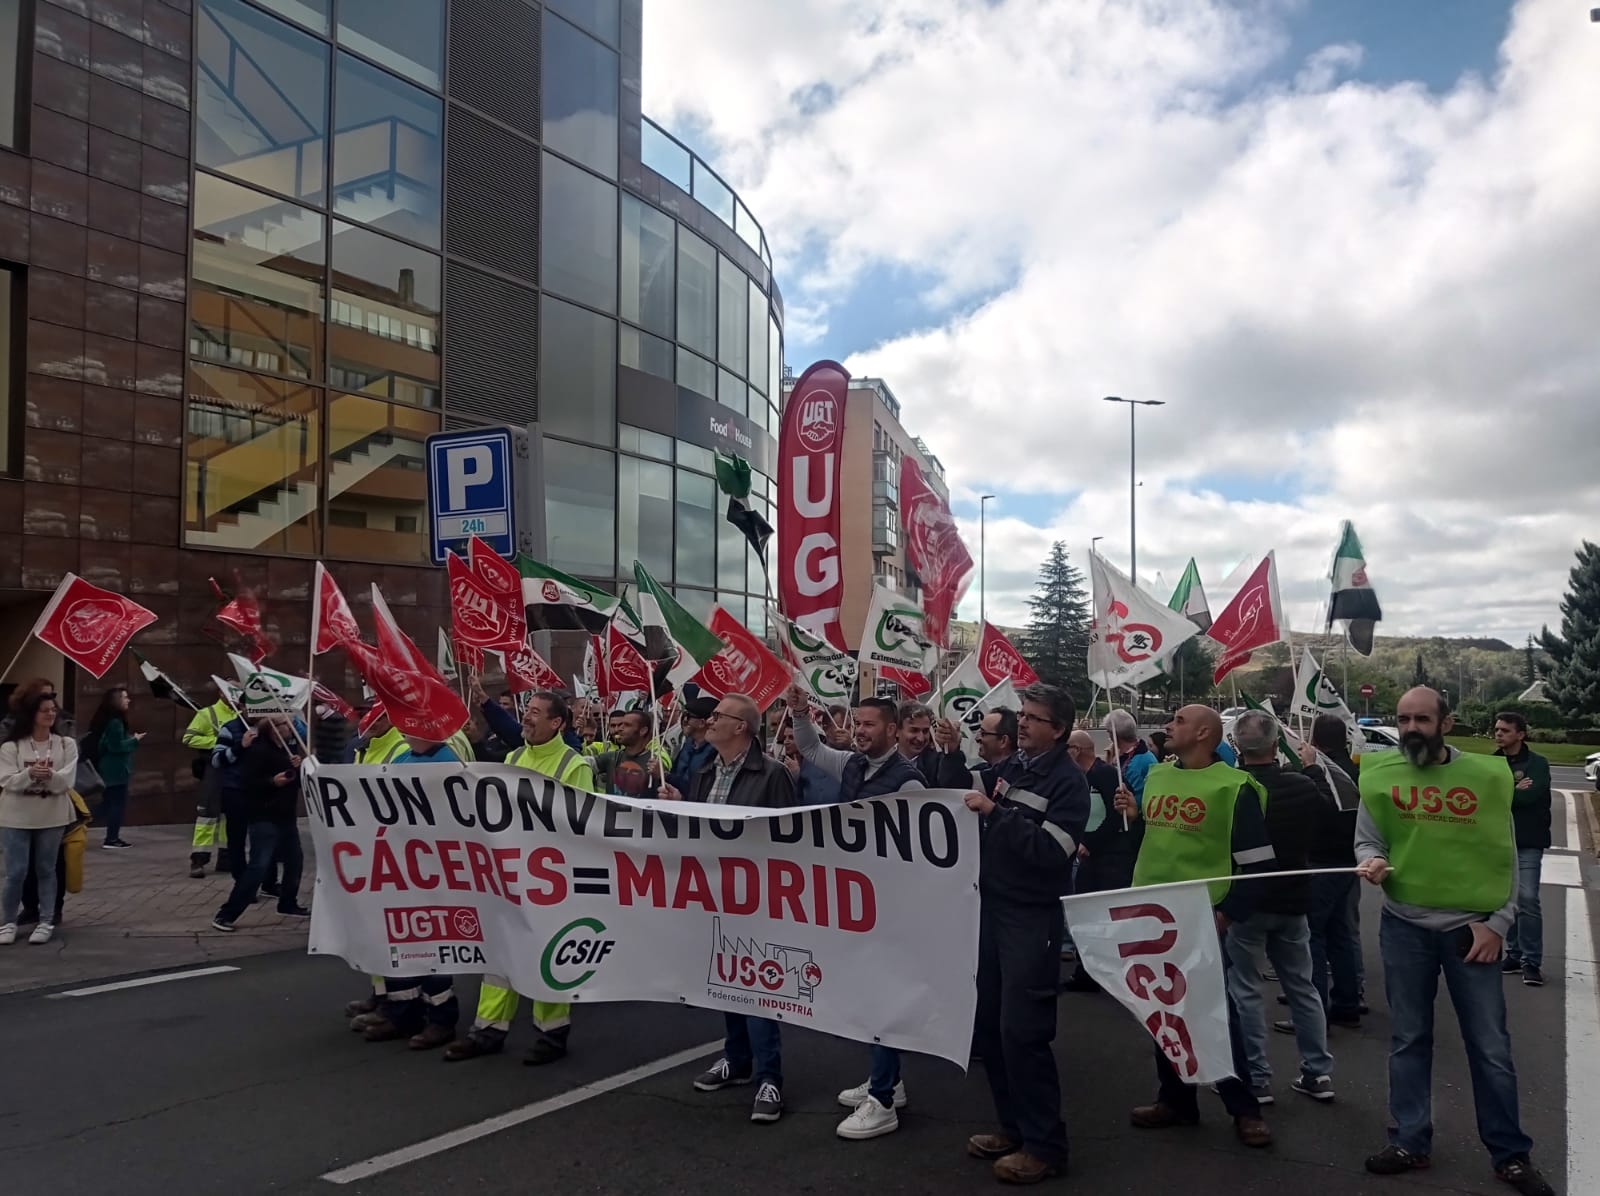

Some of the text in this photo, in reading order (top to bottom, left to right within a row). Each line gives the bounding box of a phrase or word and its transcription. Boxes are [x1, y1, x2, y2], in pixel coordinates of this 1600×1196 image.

[803, 401, 834, 427] UGT
[710, 416, 752, 449] Food House
[446, 444, 494, 511] P
[462, 518, 485, 533] 24h
[793, 453, 840, 648] UGT
[457, 582, 500, 622] UGT
[358, 777, 436, 826] UN
[1146, 795, 1207, 824] USO
[1391, 785, 1478, 816] USO
[387, 910, 449, 939] UGT
[401, 945, 487, 964] Extremadura FICA
[555, 939, 616, 966] CSIF
[716, 952, 785, 991] USO
[707, 988, 813, 1018] Federación INDUSTRIA
